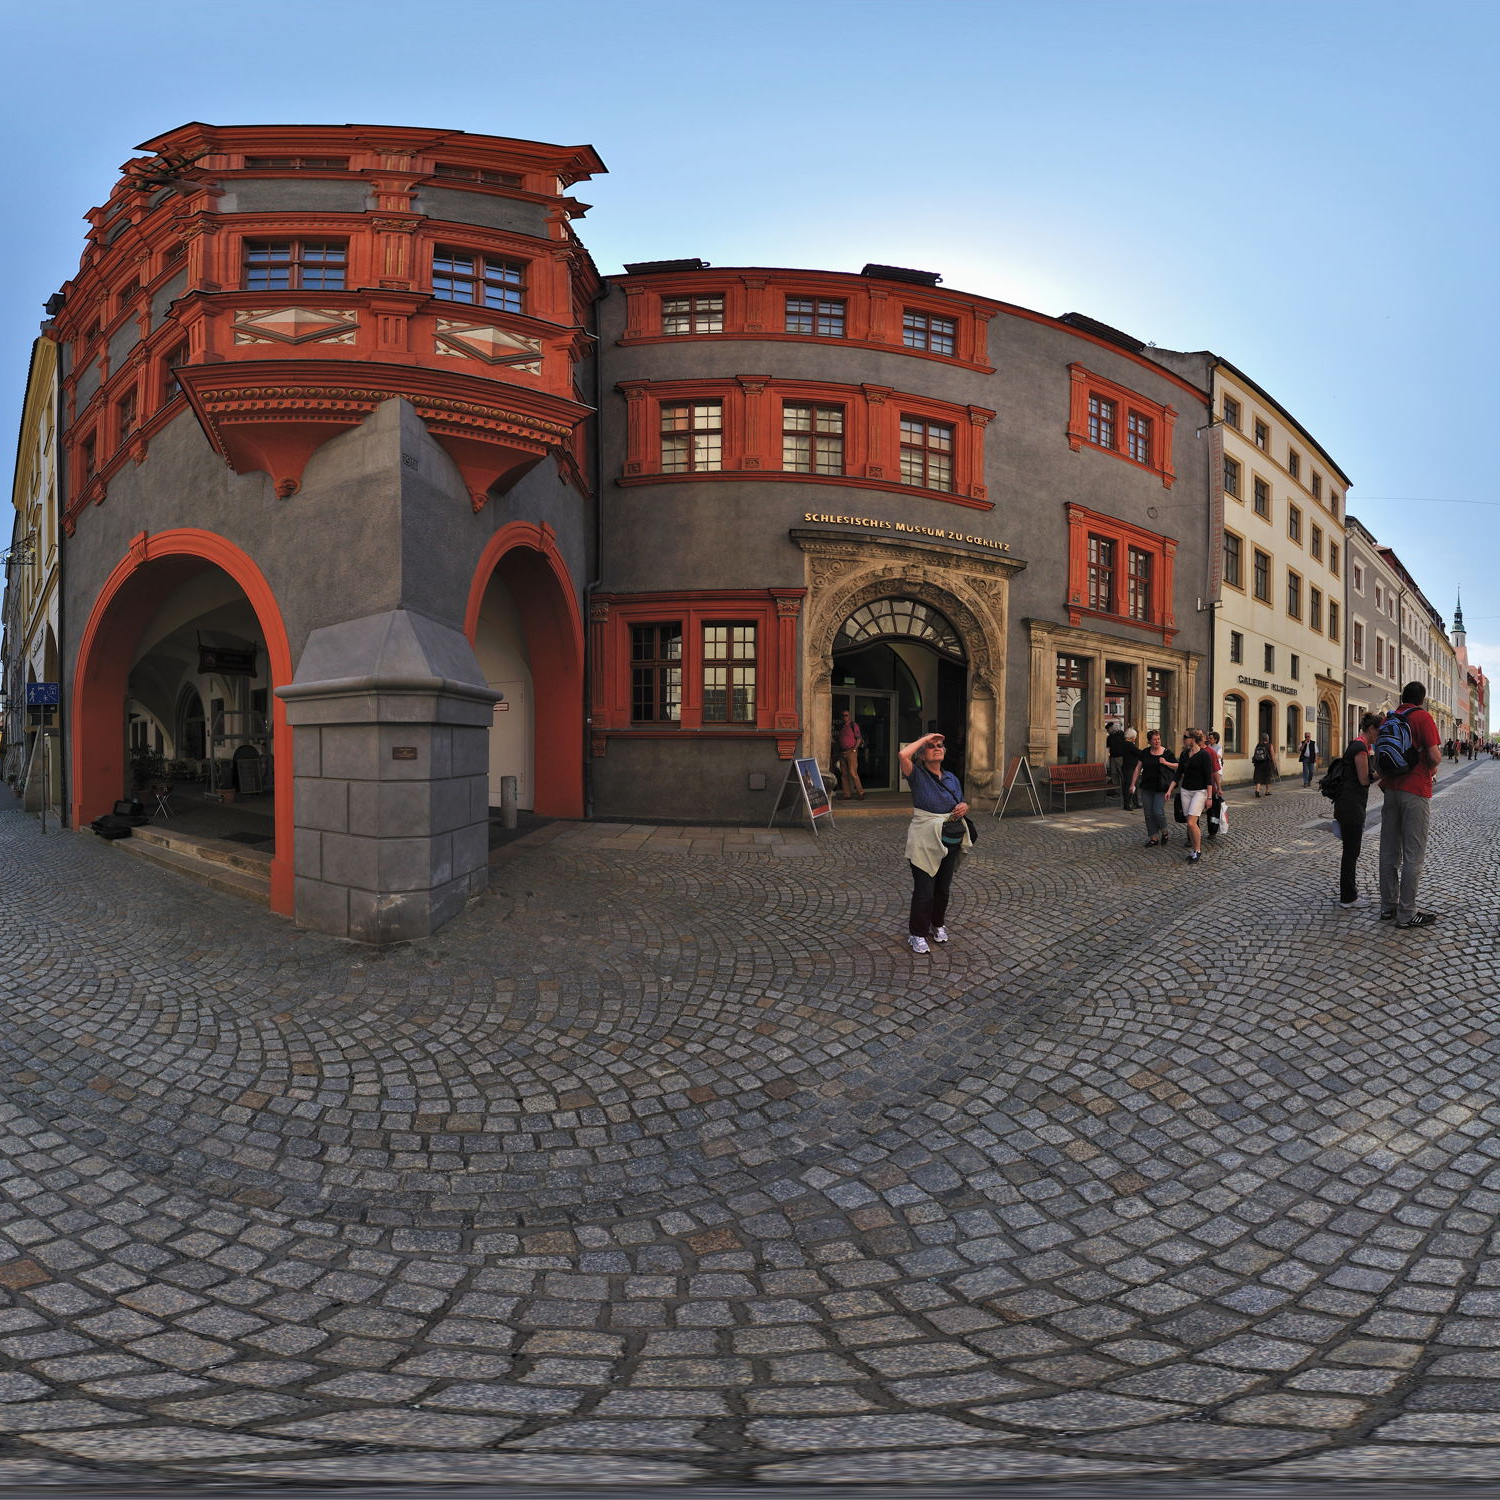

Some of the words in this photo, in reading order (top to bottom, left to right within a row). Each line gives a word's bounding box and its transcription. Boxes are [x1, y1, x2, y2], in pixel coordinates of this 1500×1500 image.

[804, 513, 892, 529] SCHLESISCHES
[895, 522, 945, 538] MUSEUM
[948, 531, 963, 541] ZU
[1238, 674, 1269, 689] GALERIE
